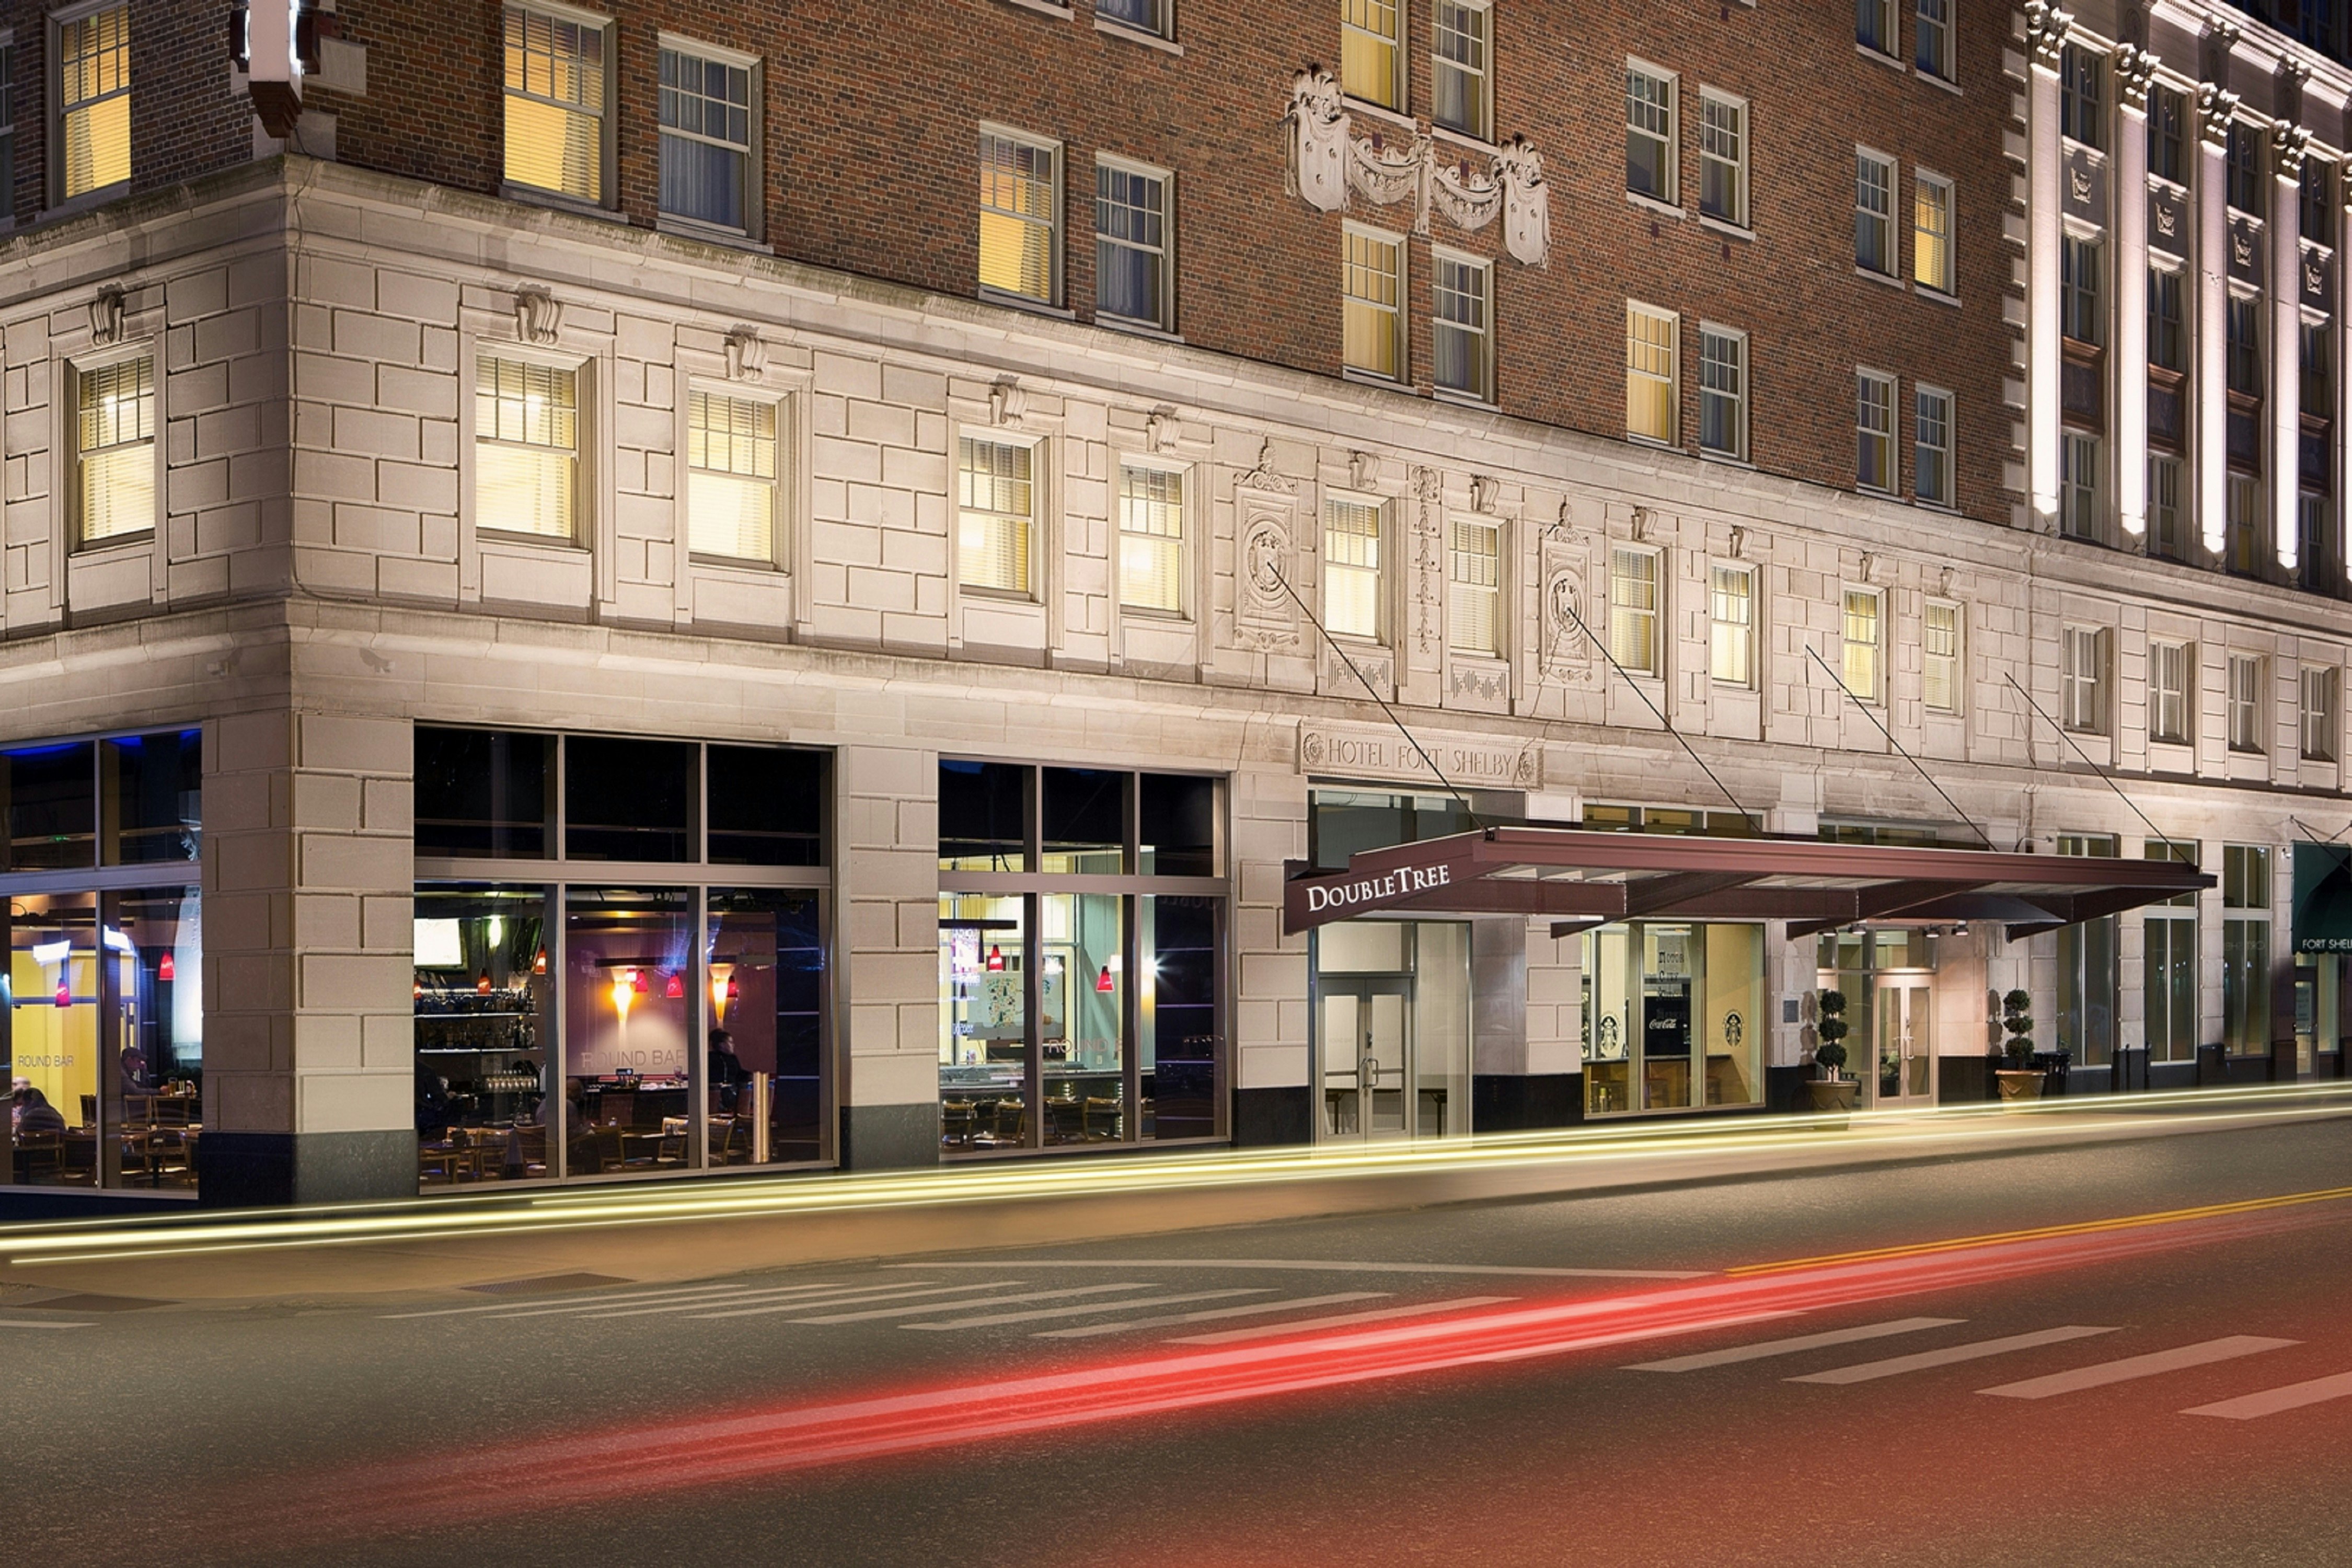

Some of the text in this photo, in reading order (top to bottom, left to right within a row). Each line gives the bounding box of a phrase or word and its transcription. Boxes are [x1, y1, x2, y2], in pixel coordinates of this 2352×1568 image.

[1329, 738, 1513, 776] HOTEL FORT SHELBY
[2302, 939, 2326, 949] FORT
[18, 1055, 74, 1068] ROUND BAR
[581, 1051, 647, 1068] ROUND
